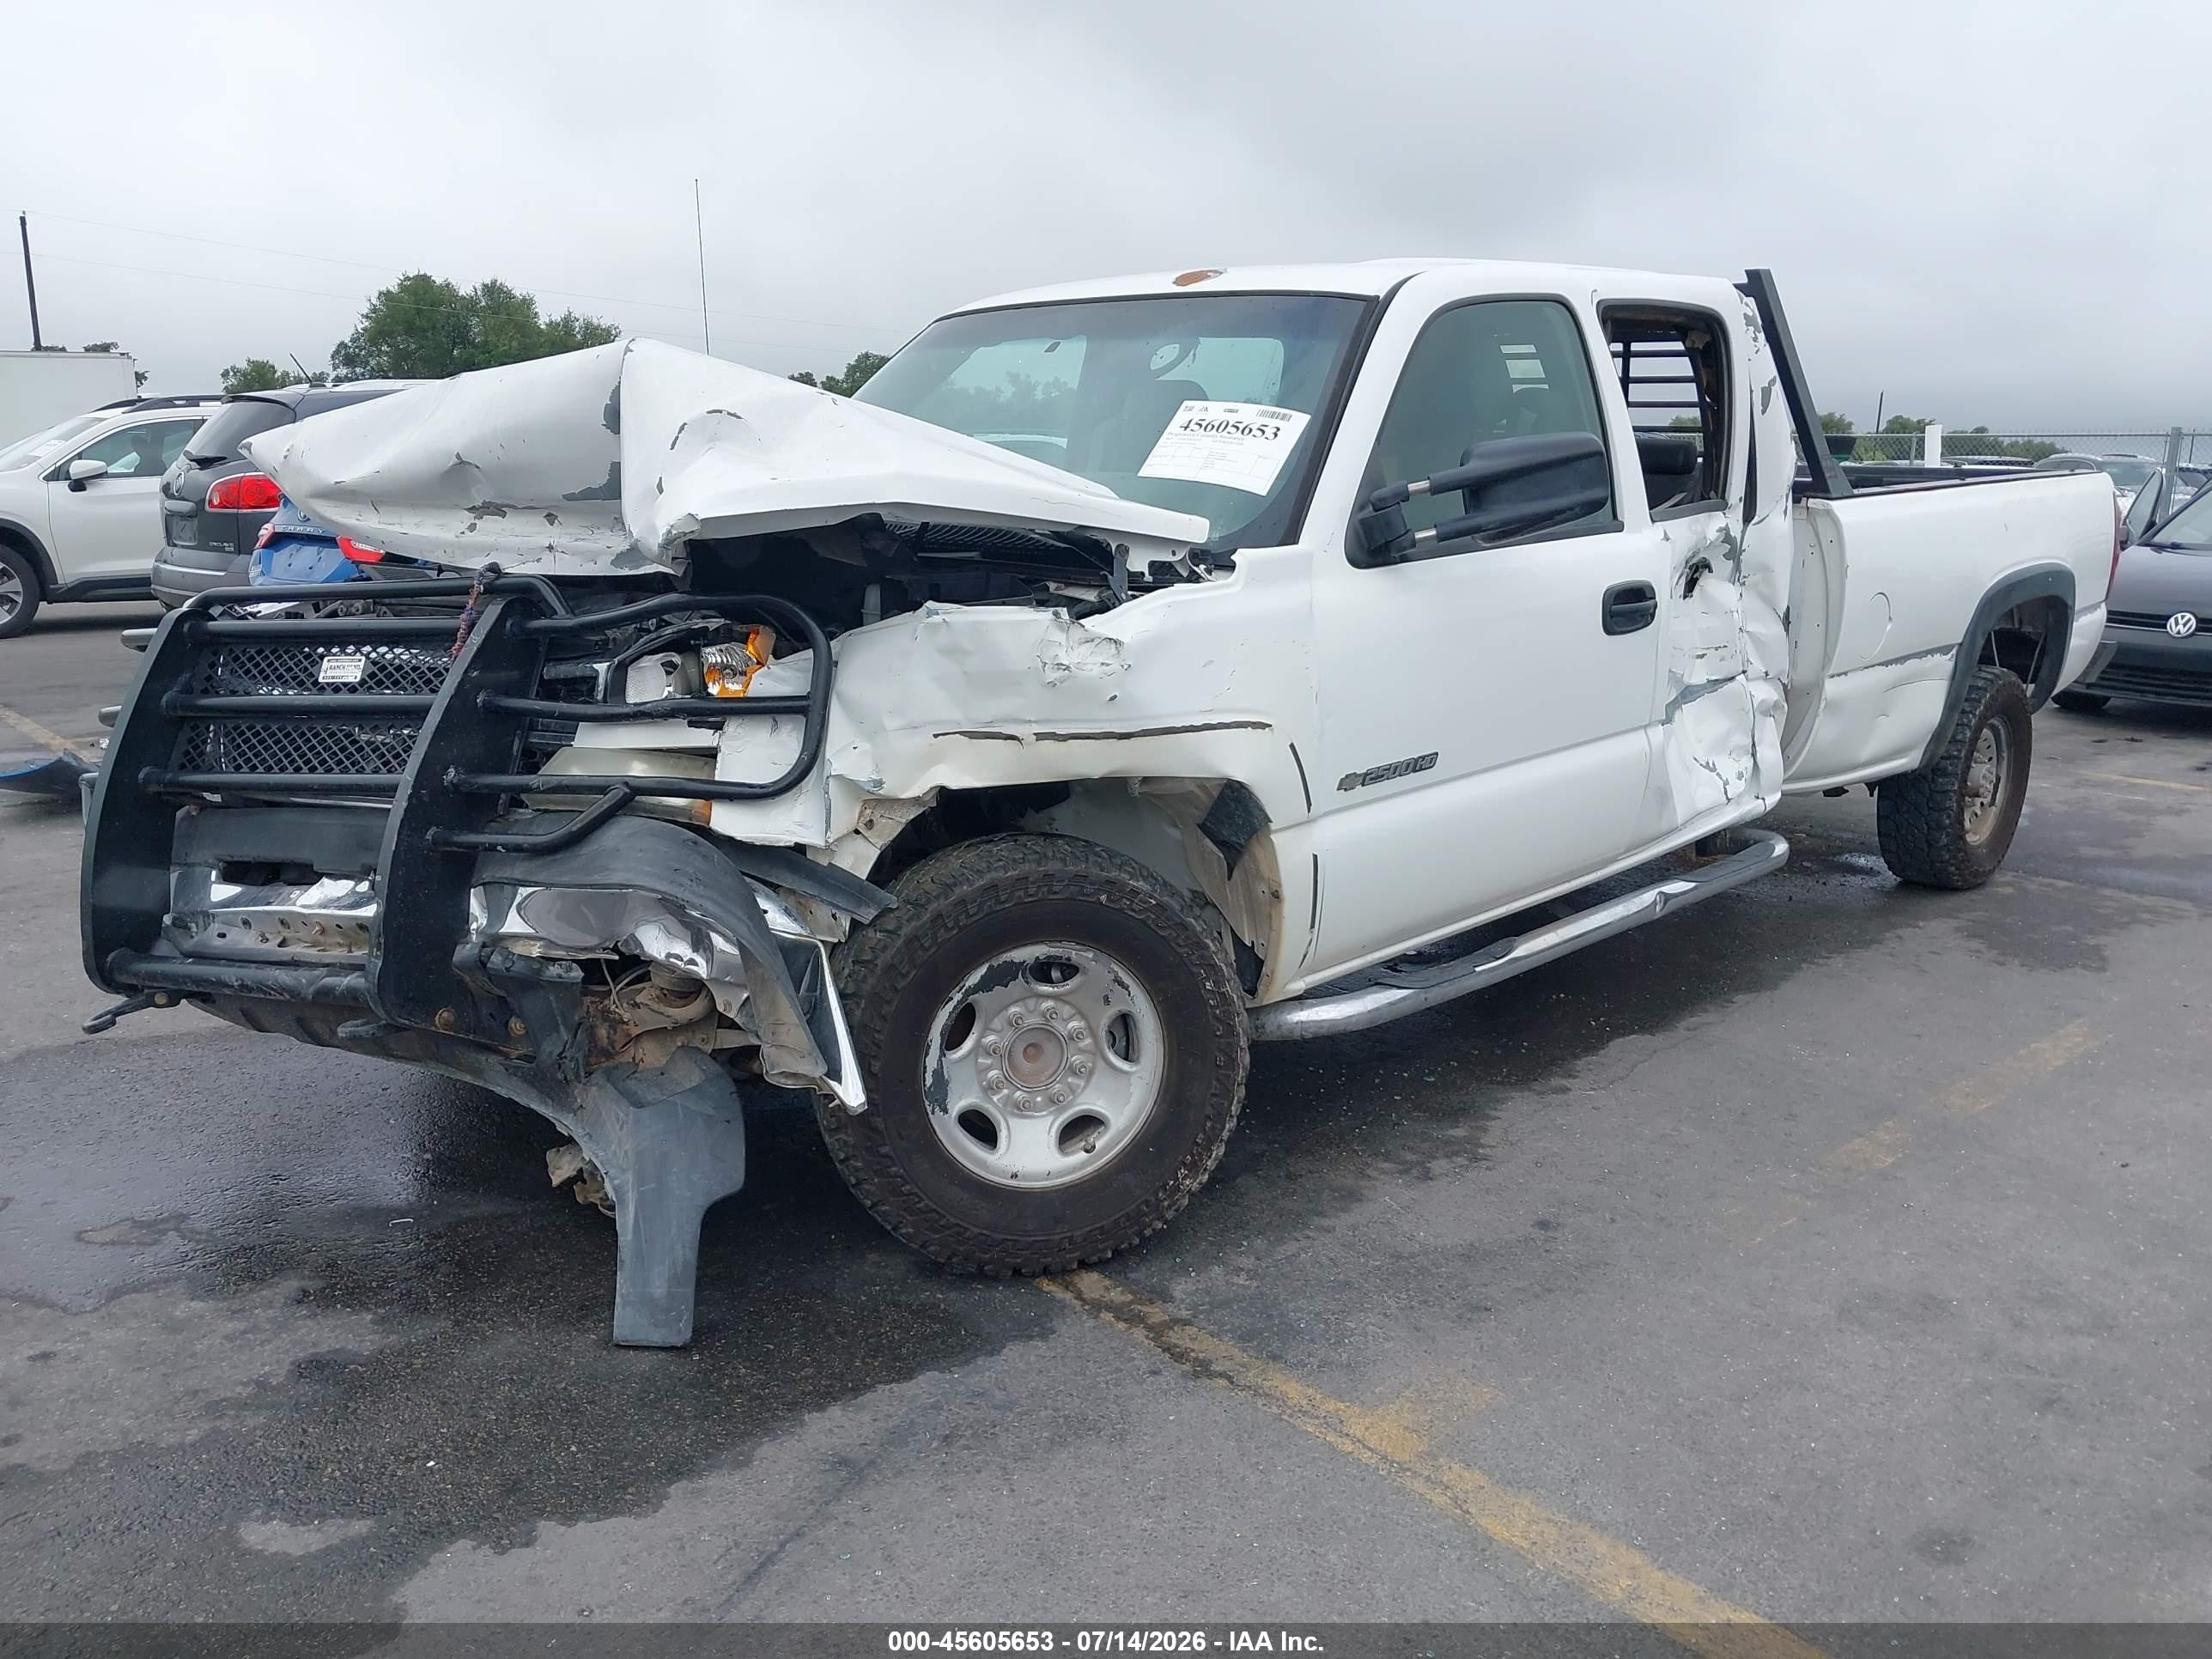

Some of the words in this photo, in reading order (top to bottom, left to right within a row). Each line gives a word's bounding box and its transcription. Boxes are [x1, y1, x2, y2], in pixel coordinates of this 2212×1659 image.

[1180, 417, 1280, 441] 45605653
[1363, 758, 1415, 786] 2500
[1416, 754, 1437, 771] HD
